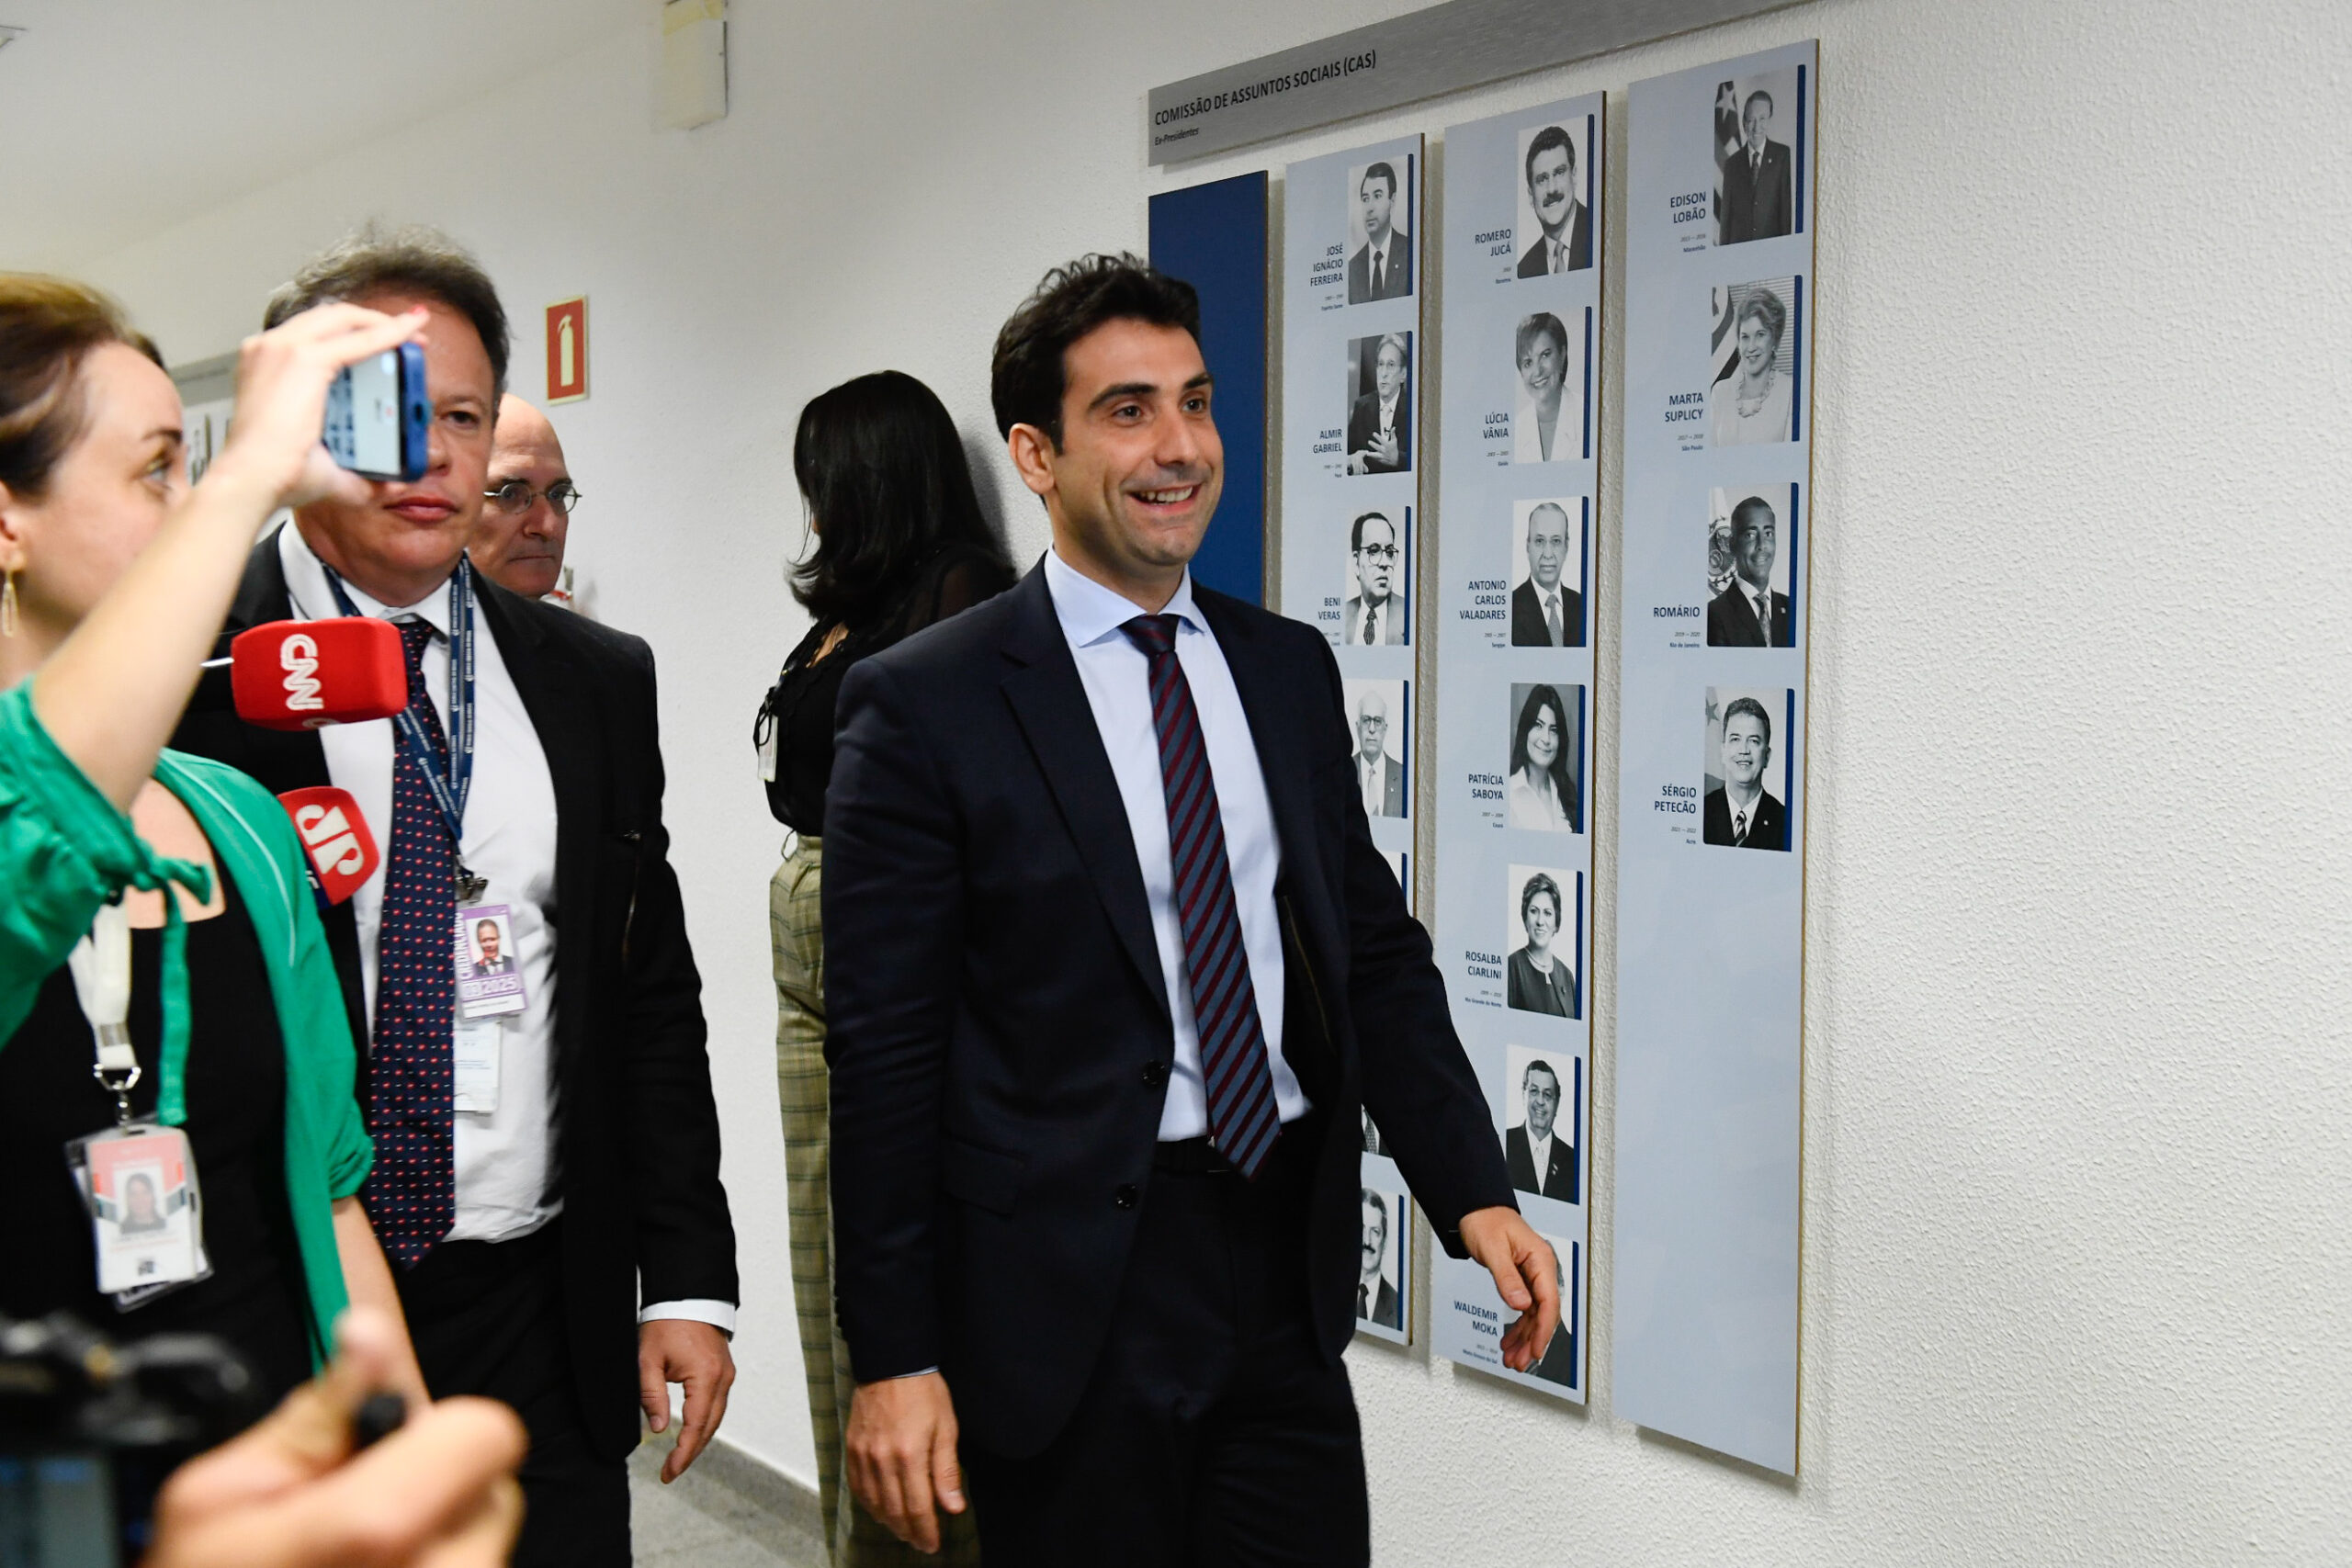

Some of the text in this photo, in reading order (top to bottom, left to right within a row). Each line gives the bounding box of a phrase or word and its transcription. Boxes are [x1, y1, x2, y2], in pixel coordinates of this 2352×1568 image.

[1154, 49, 1376, 125] COMISSÃO DE ASSUNTOS SOCIAIS (CAS)
[1154, 127, 1199, 145] Ex-Presidentes
[1670, 191, 1706, 208] EDISON
[1673, 207, 1706, 223] LOBÃO
[1475, 229, 1511, 243] ROMERO
[1326, 242, 1343, 256] JOSÉ
[1490, 241, 1511, 256] JUCÁ
[1313, 258, 1343, 272] IGNÁCIO
[1310, 273, 1343, 287] FERREIRA
[1668, 392, 1703, 405] MARTA
[1485, 412, 1509, 424] LÚCIA
[1665, 408, 1703, 423] SUPLICY
[1319, 428, 1342, 439] ALMIR
[1483, 426, 1509, 439] VÂNIA
[1313, 443, 1342, 454] GABRIEL
[1468, 580, 1507, 591] ANTONIO
[1324, 597, 1340, 606] BENI
[1475, 594, 1507, 605] CARLOS
[1317, 611, 1340, 620] VERAS
[1459, 610, 1507, 620] VALADARES
[1653, 604, 1701, 617] ROMÁRIO
[280, 634, 324, 711] CNN
[1468, 773, 1504, 785] PATRÍCIA
[1472, 788, 1504, 800] SABOYA
[1661, 783, 1697, 798] SÉRGIO
[1654, 800, 1697, 814] PETECÃO
[1465, 950, 1502, 965] ROSALBA
[1467, 965, 1502, 980] CIARLINI
[1453, 1300, 1498, 1322] WALDEMIR
[1472, 1320, 1498, 1337] MOKA
